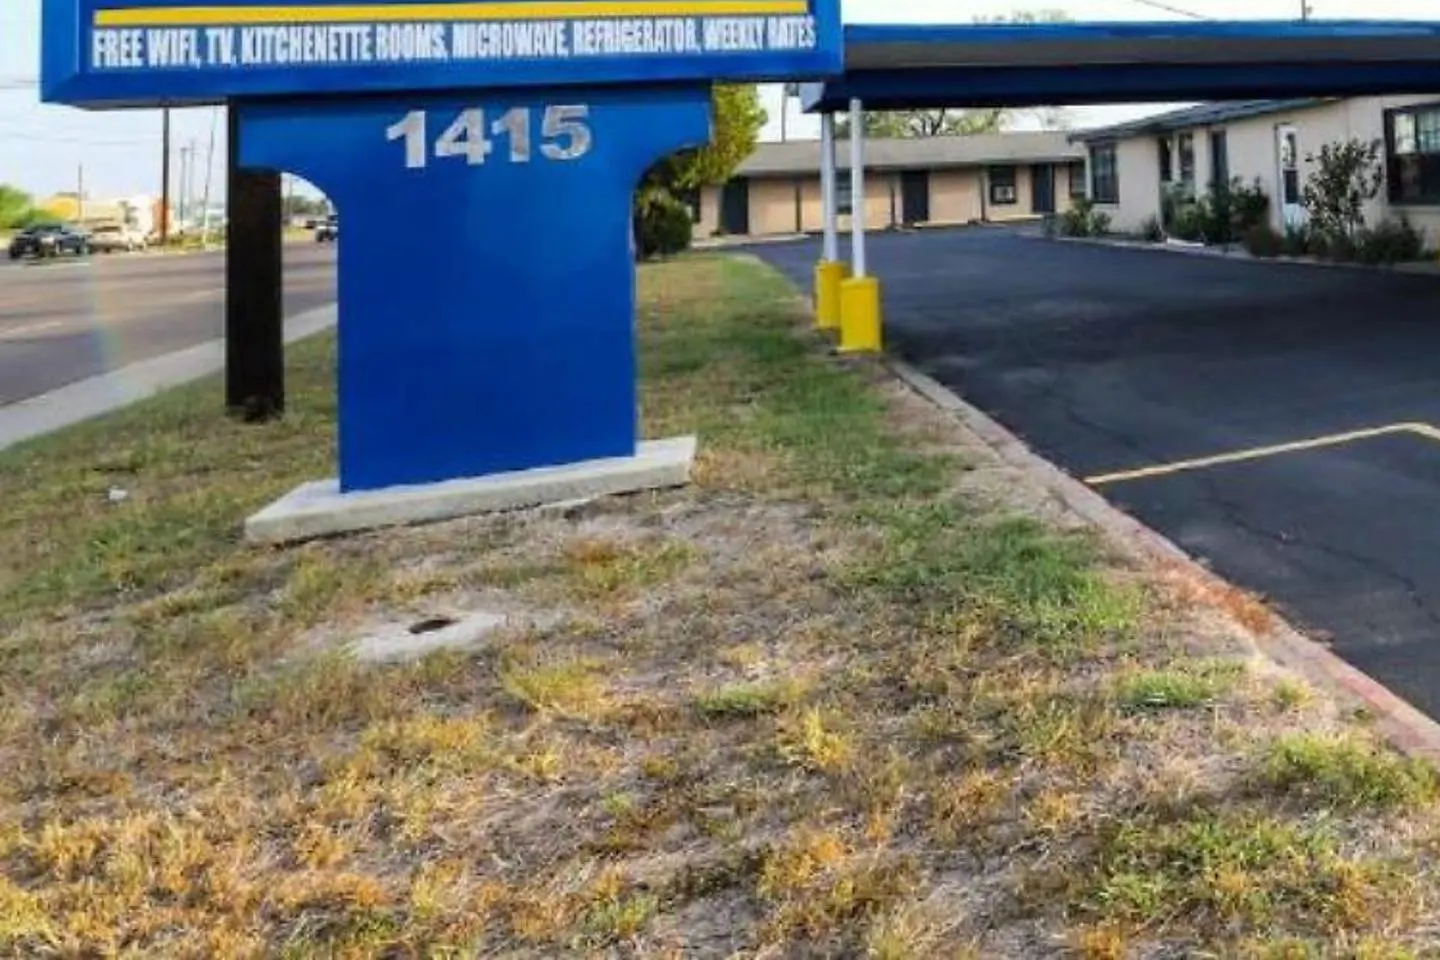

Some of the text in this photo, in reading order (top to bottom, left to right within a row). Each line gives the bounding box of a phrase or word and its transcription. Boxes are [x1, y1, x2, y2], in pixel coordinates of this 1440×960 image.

[92, 27, 143, 67] FREE
[240, 25, 373, 65] KITCHENETTE
[703, 17, 766, 52] WEEKLY
[768, 15, 816, 50] RATES
[386, 104, 592, 170] 1415
